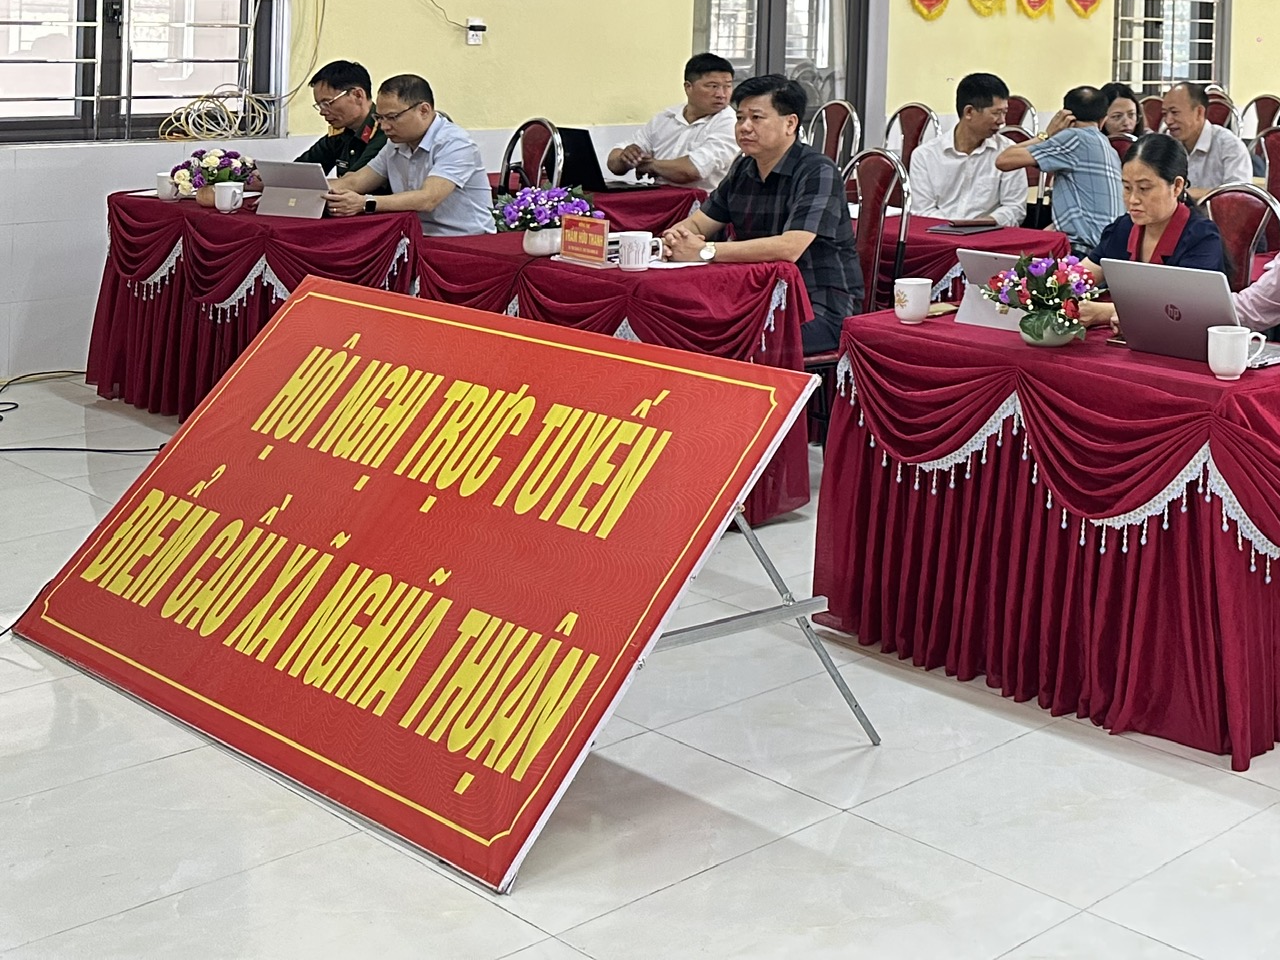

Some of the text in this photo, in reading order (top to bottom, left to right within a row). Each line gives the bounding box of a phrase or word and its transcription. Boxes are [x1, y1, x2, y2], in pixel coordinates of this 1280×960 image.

[251, 333, 673, 540] HỘI NGHỊ TRỰC TUYẾN
[80, 463, 601, 795] ĐIỂM CẦU XÃ NGHĨA THUẬN
